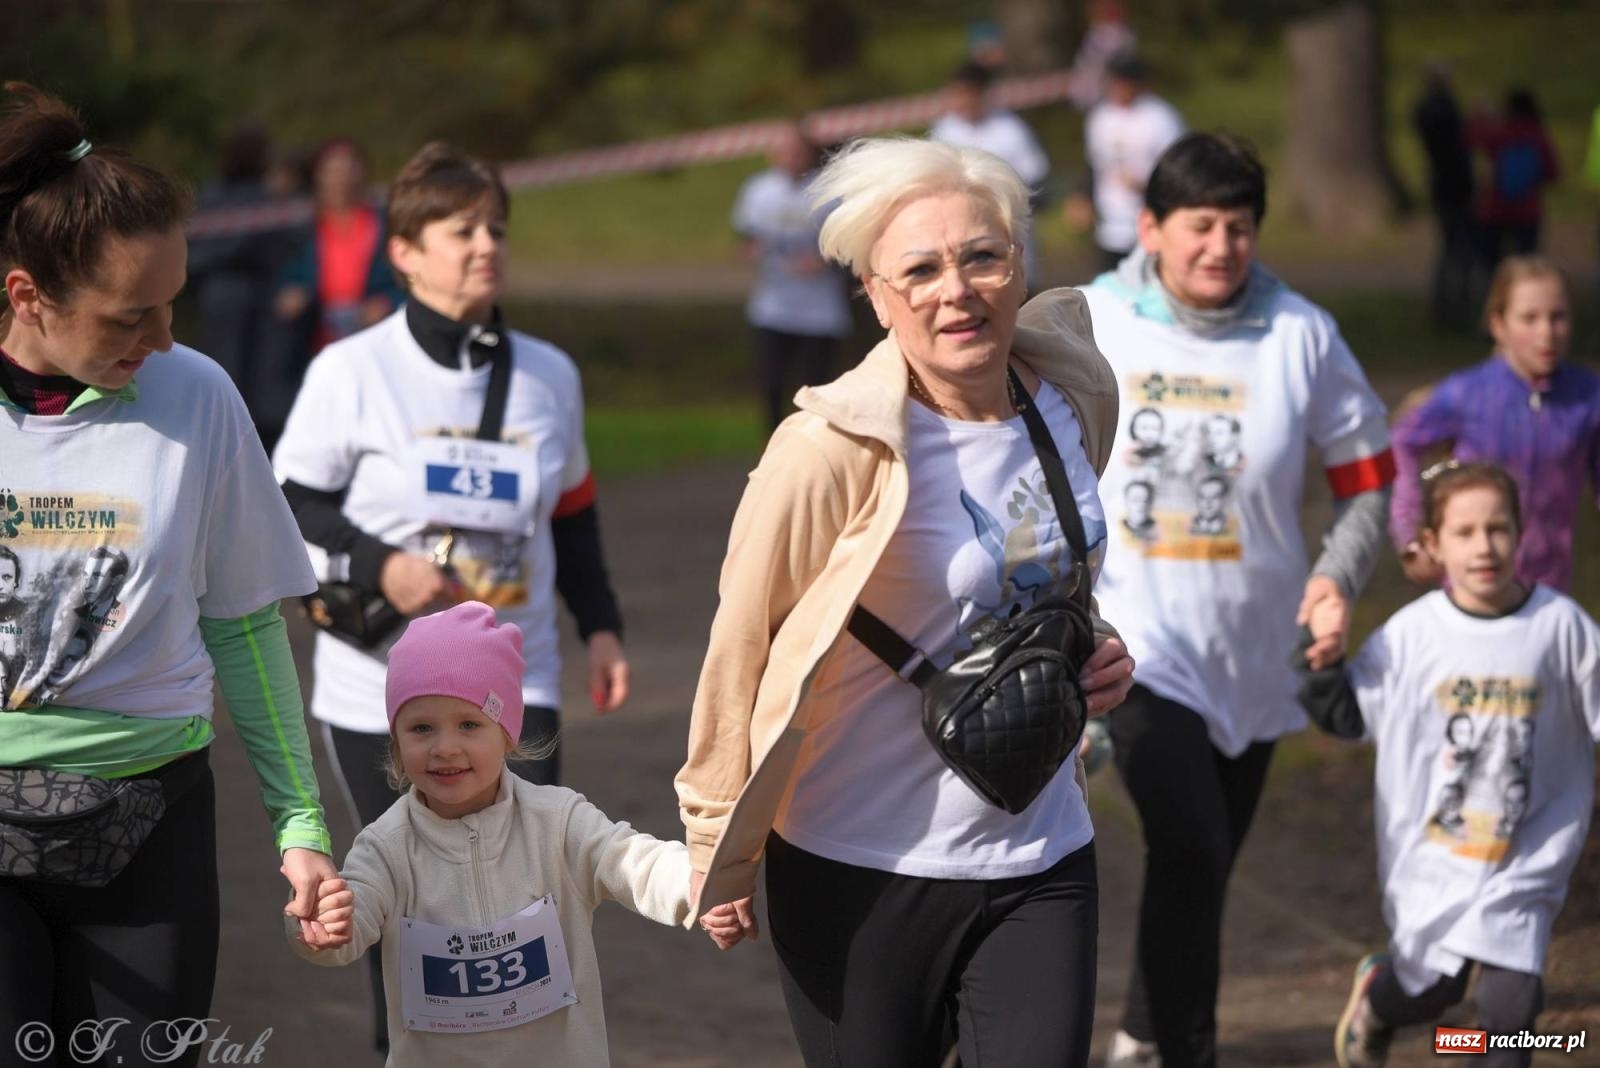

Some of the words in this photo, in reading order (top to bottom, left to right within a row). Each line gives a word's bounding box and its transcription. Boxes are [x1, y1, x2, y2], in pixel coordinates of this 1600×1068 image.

[451, 467, 493, 498] 43
[29, 497, 74, 509] TROPEM
[31, 510, 116, 529] WILCZYM
[468, 931, 493, 942] TROPEM
[470, 930, 516, 952] WILCZYM
[448, 951, 527, 994] 133
